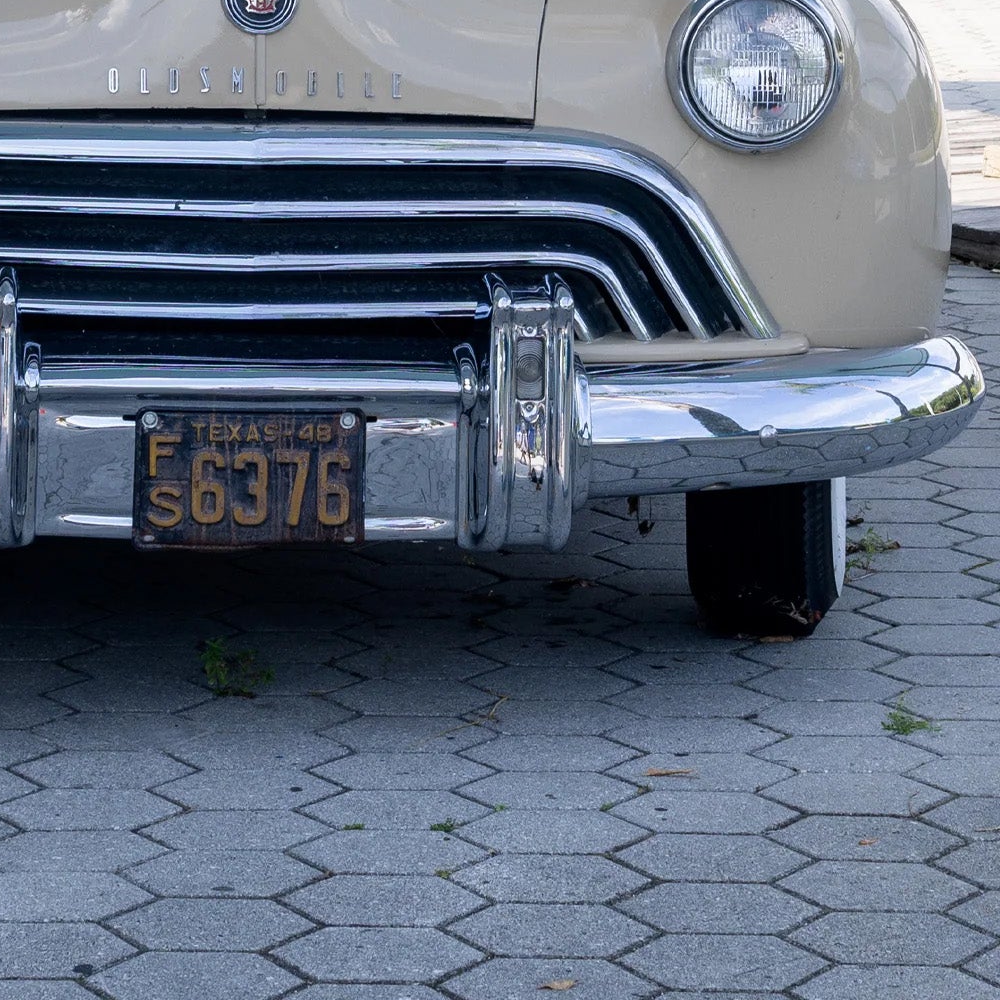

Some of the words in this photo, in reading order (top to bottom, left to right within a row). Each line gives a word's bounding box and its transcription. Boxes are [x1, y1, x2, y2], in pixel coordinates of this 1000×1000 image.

[107, 66, 403, 99] OLDSMOBILE
[148, 434, 182, 478] F
[147, 485, 183, 528] S
[190, 450, 351, 527] 6376
